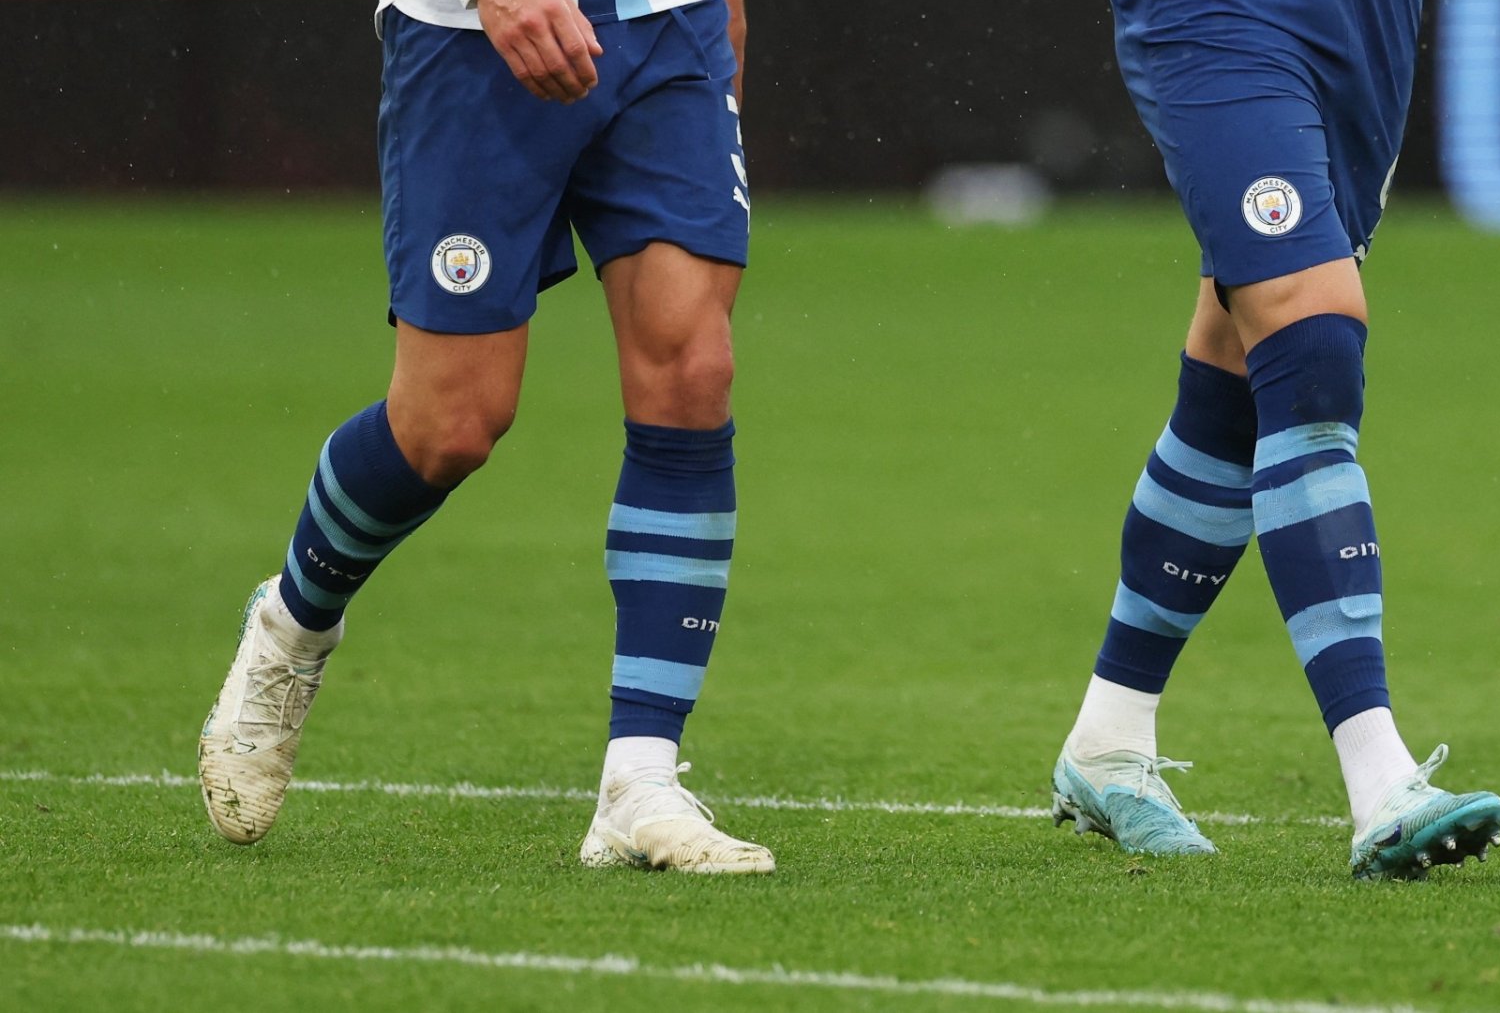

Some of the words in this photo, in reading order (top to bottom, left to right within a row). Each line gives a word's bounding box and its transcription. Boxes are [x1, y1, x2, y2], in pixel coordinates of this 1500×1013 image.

[1246, 179, 1294, 204] MANCHESTER
[1269, 224, 1288, 233] CITY
[436, 237, 486, 256] MANCHESTER
[1162, 561, 1226, 585] CITY
